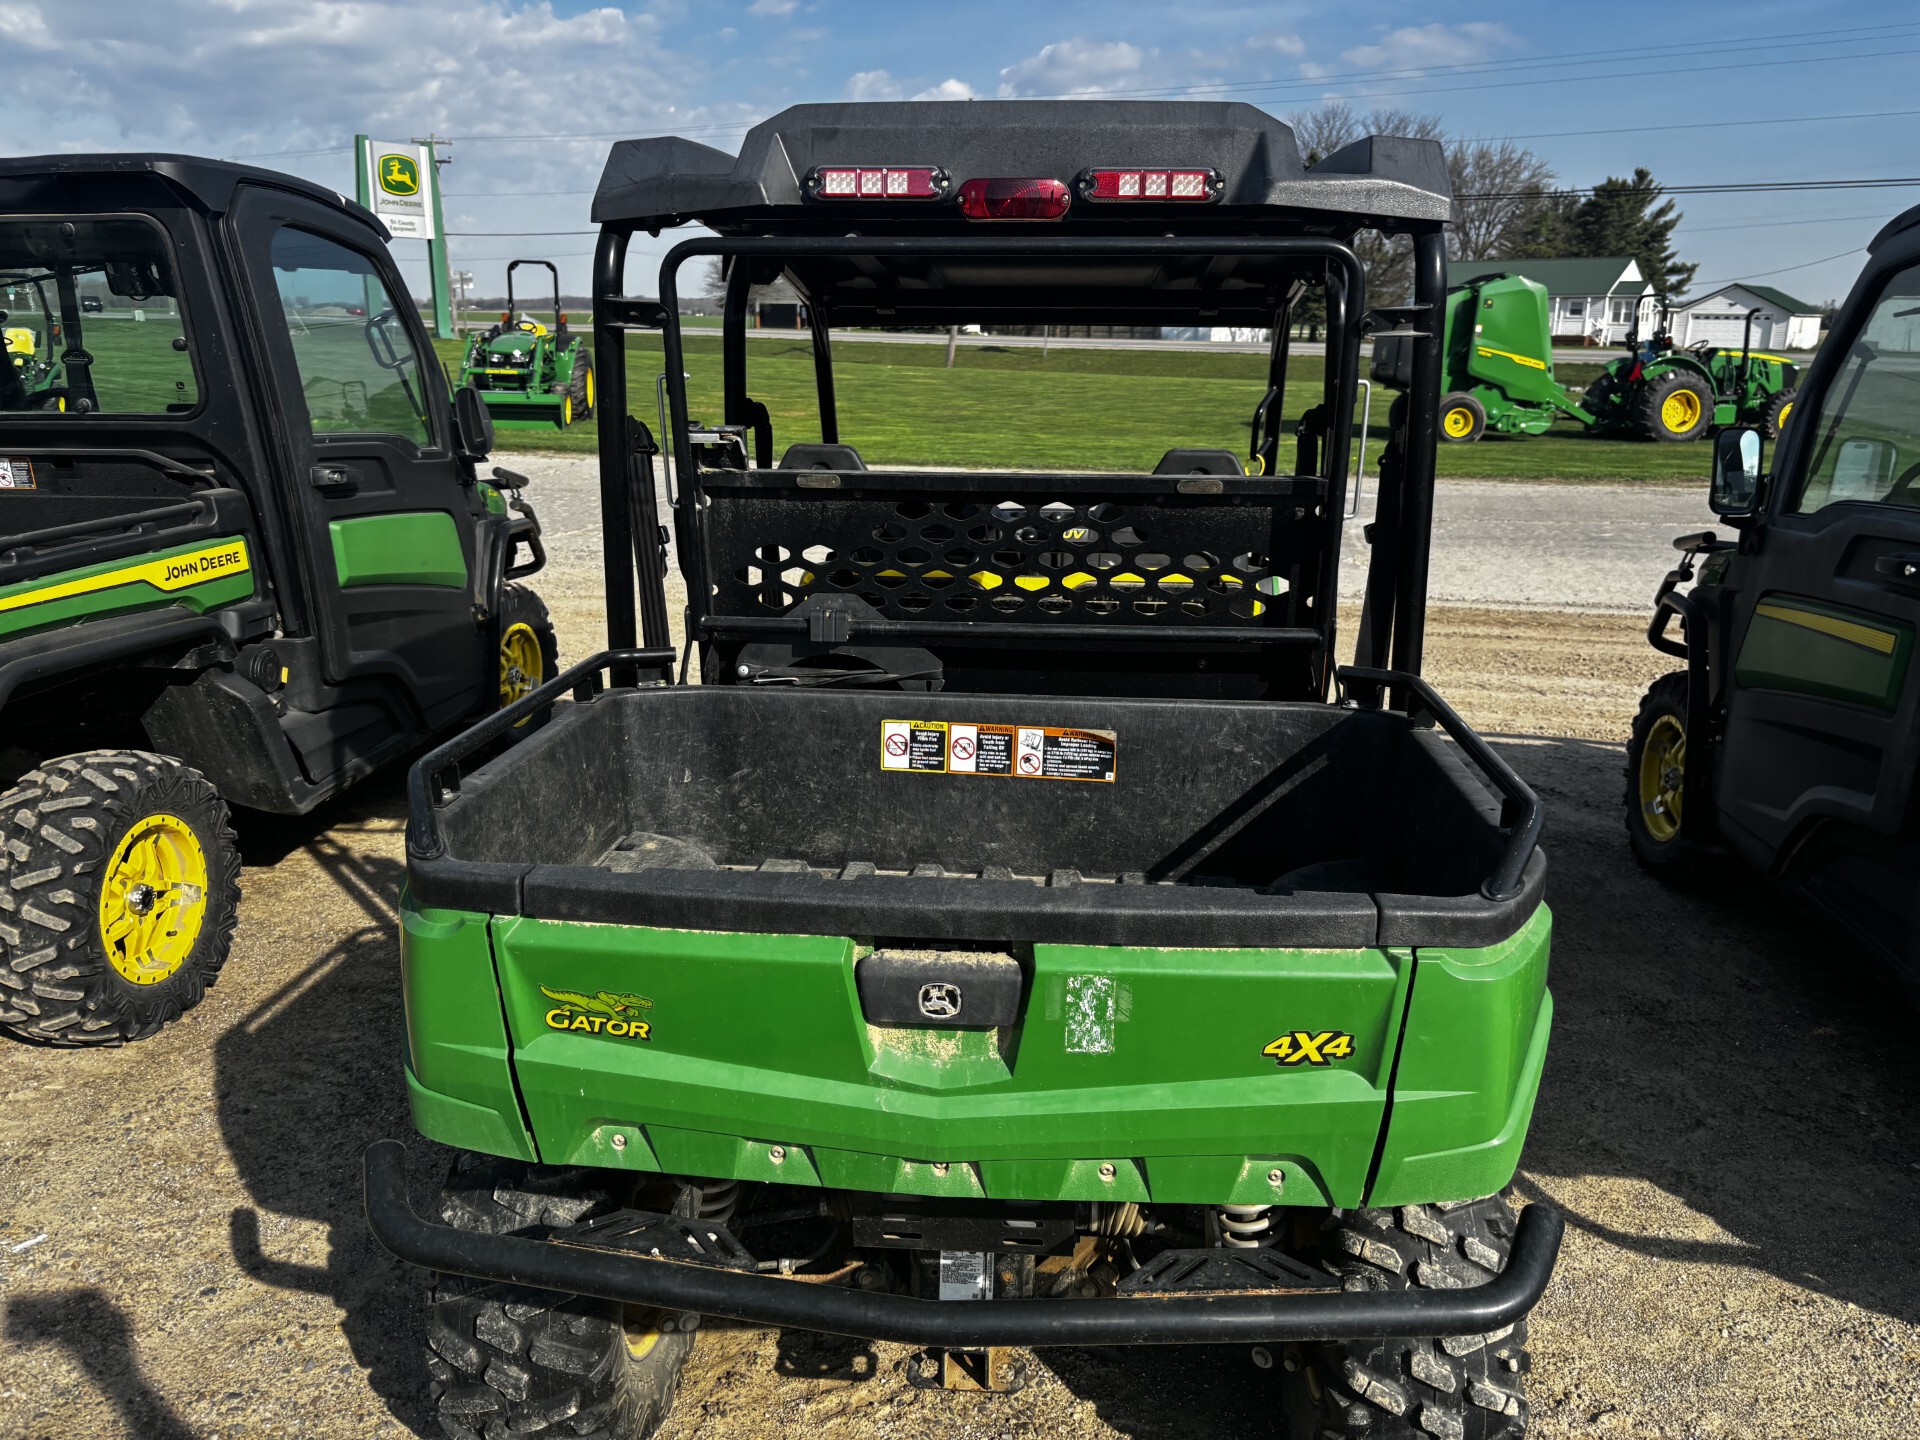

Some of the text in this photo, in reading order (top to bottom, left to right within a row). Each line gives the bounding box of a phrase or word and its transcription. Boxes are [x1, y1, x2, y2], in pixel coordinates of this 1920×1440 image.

[164, 551, 240, 582] JOHN DEERE
[985, 726, 1014, 734] WARNING
[545, 1008, 651, 1040] GATOR
[1262, 1032, 1353, 1063] 4X4
